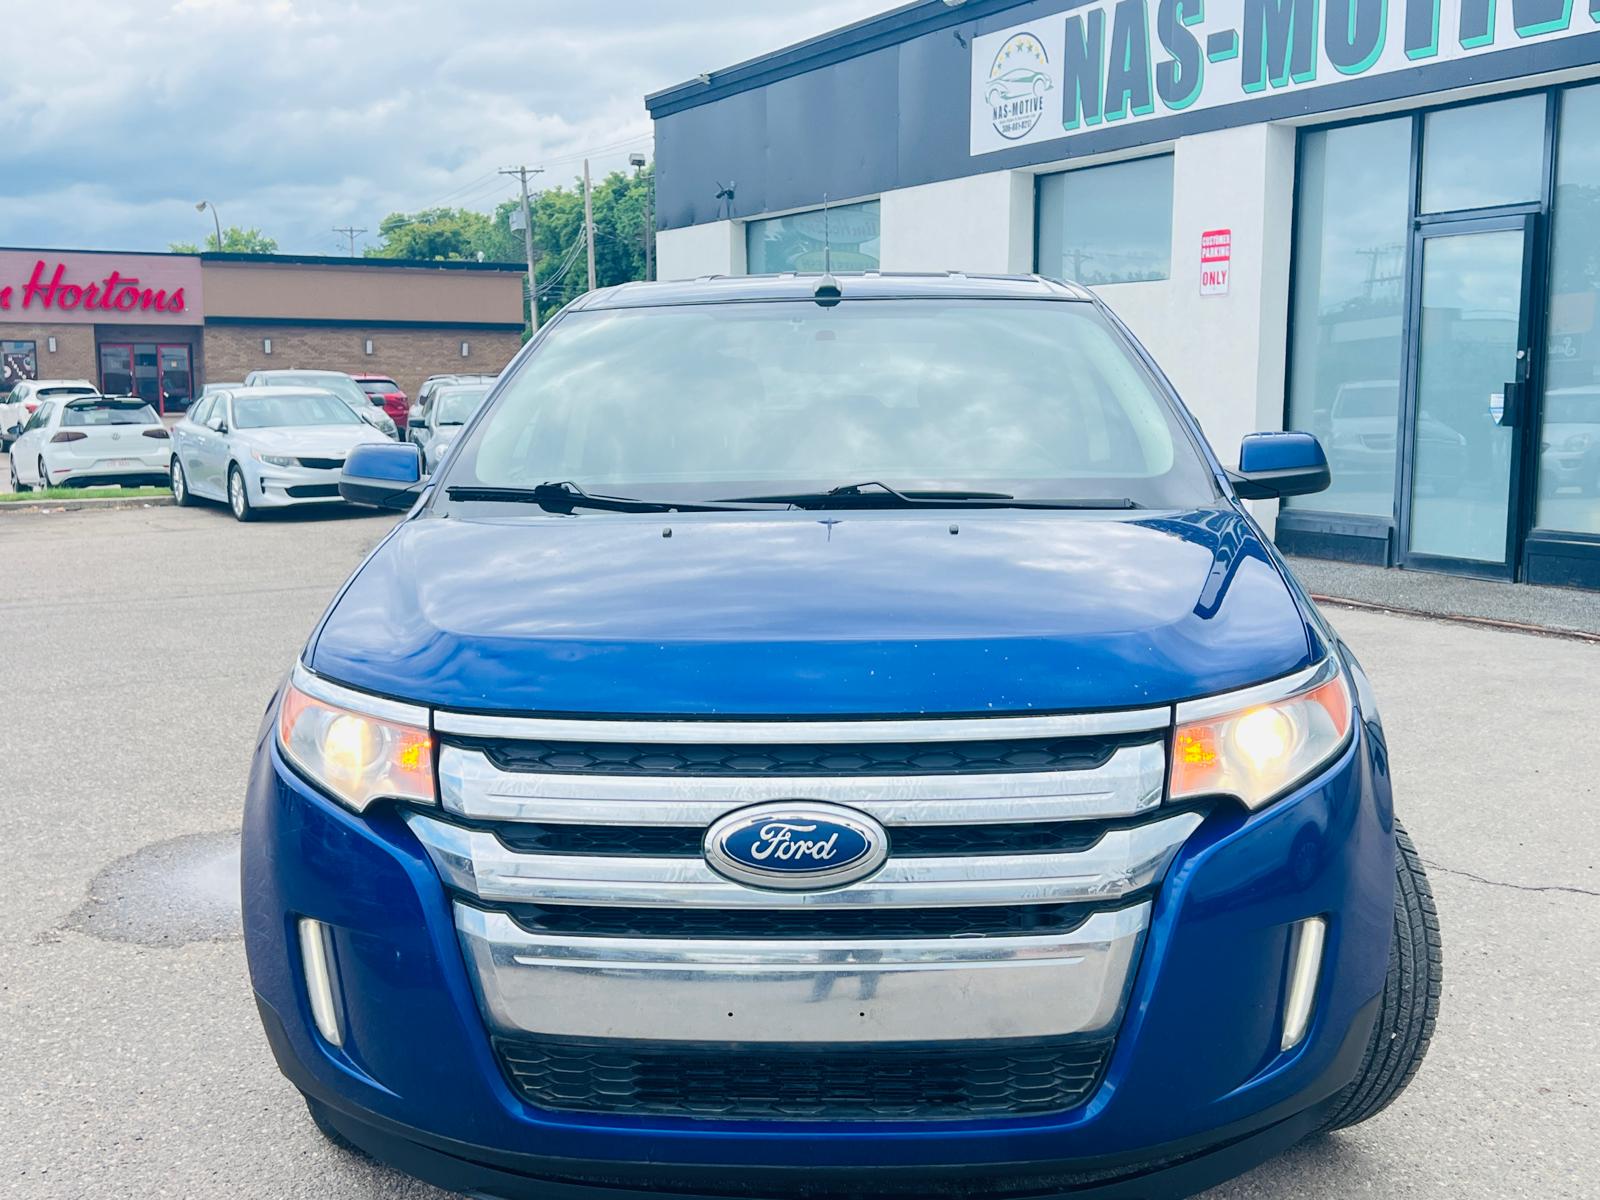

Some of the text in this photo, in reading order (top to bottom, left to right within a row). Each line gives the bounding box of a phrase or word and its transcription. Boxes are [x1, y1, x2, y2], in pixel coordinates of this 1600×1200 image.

[992, 95, 1044, 121] NAS-MOTIVE
[22, 260, 185, 314] Hortons
[1202, 270, 1228, 286] ONLY
[750, 822, 839, 861] Ford
